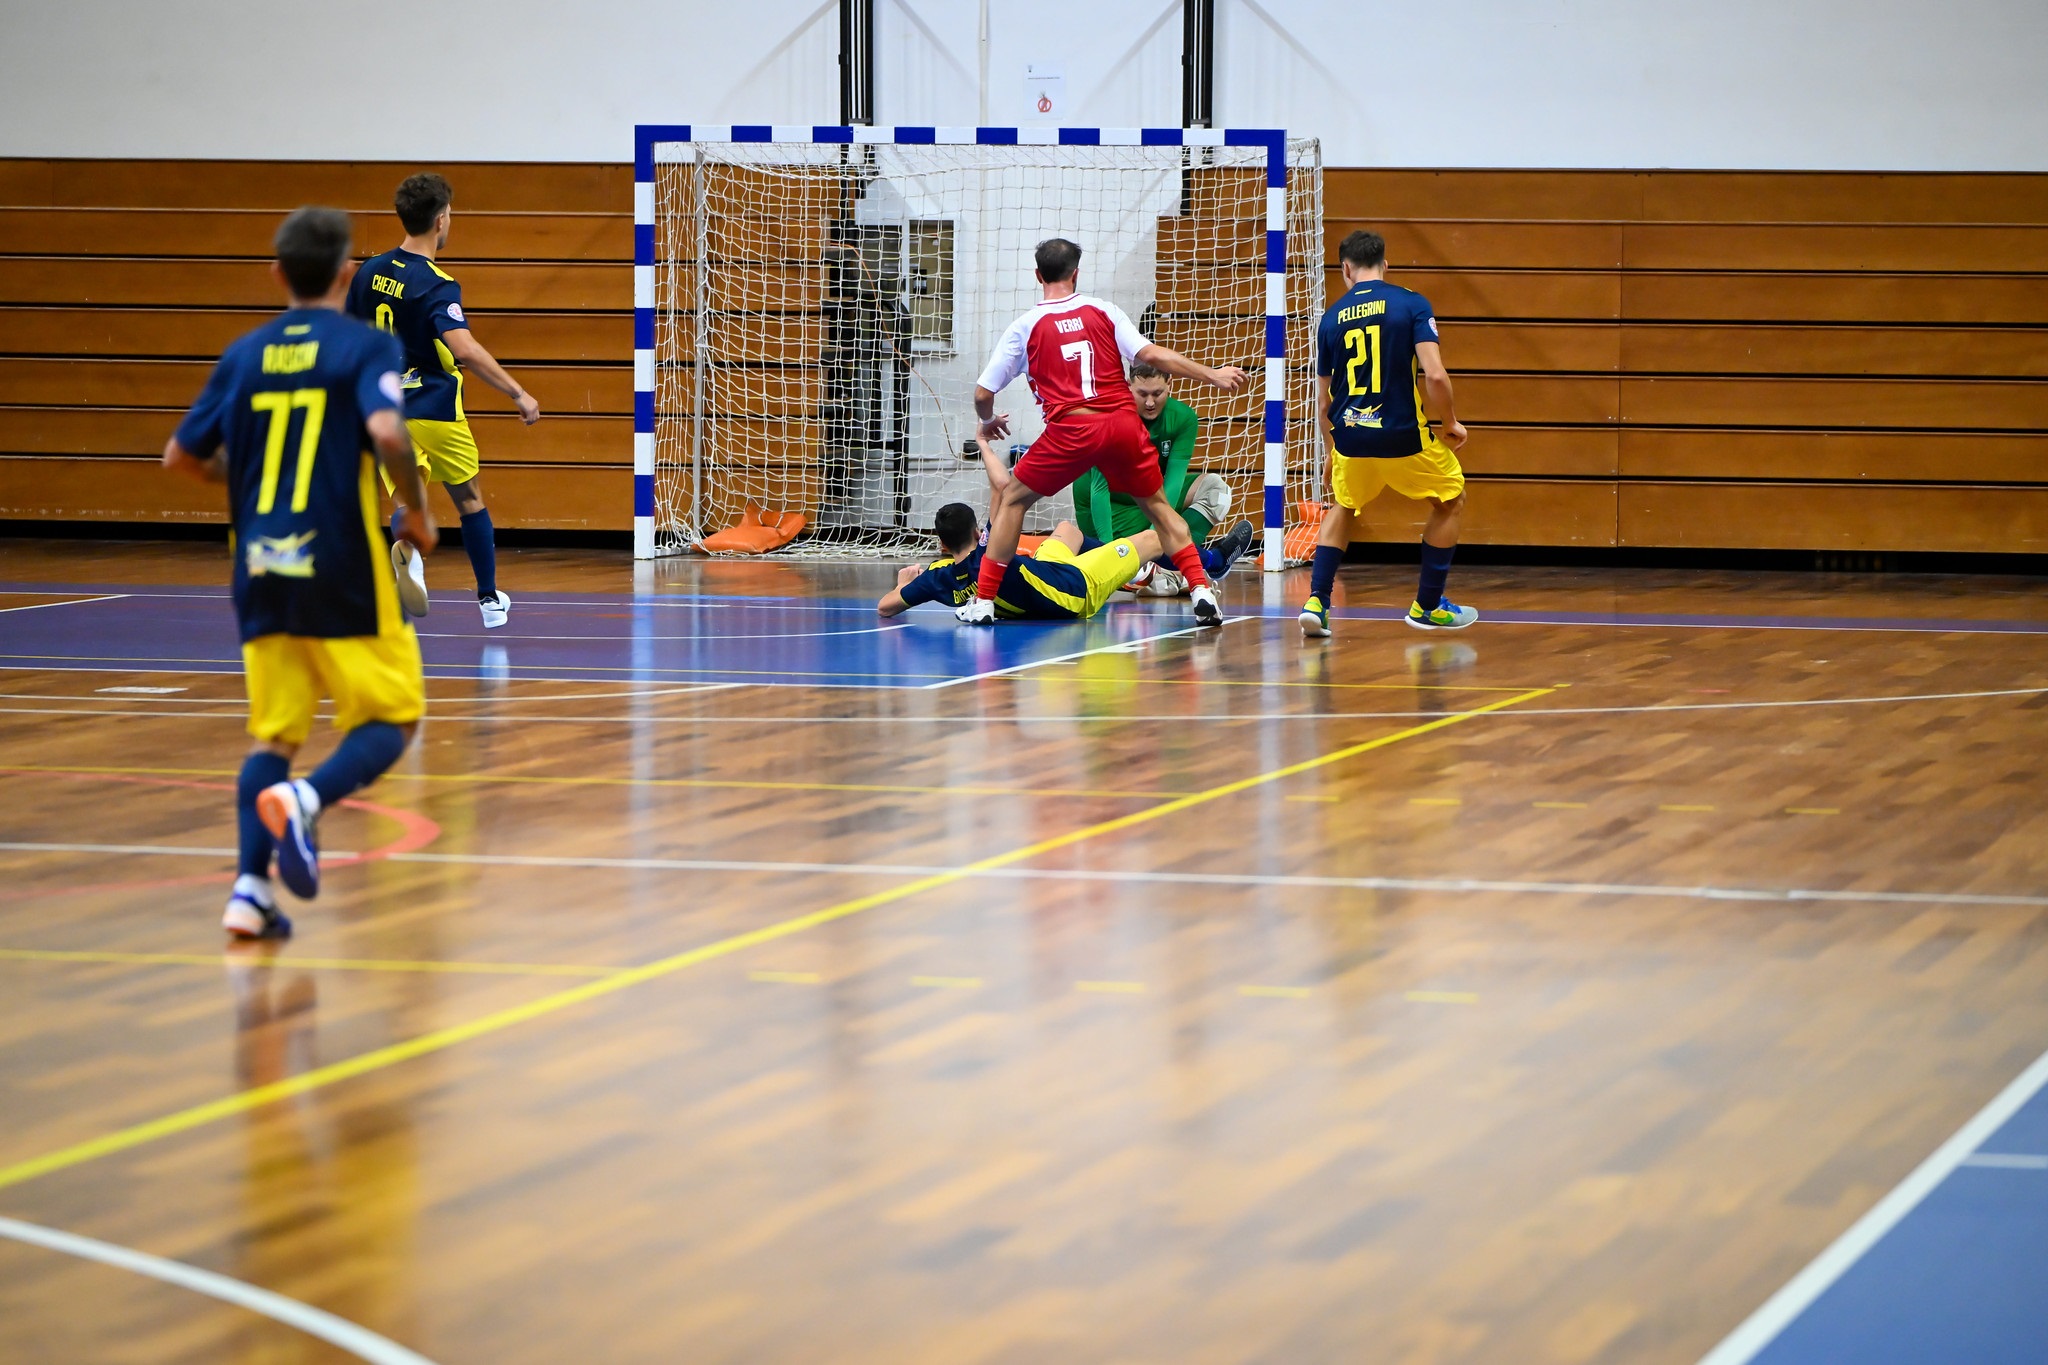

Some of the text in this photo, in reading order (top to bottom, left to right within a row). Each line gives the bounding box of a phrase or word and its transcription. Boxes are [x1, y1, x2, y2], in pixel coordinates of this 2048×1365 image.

[1054, 316, 1084, 334] VERRI
[1337, 299, 1386, 325] PELLEGRINI
[1060, 339, 1098, 401] 7
[1343, 324, 1381, 396] 21
[251, 388, 328, 515] 77
